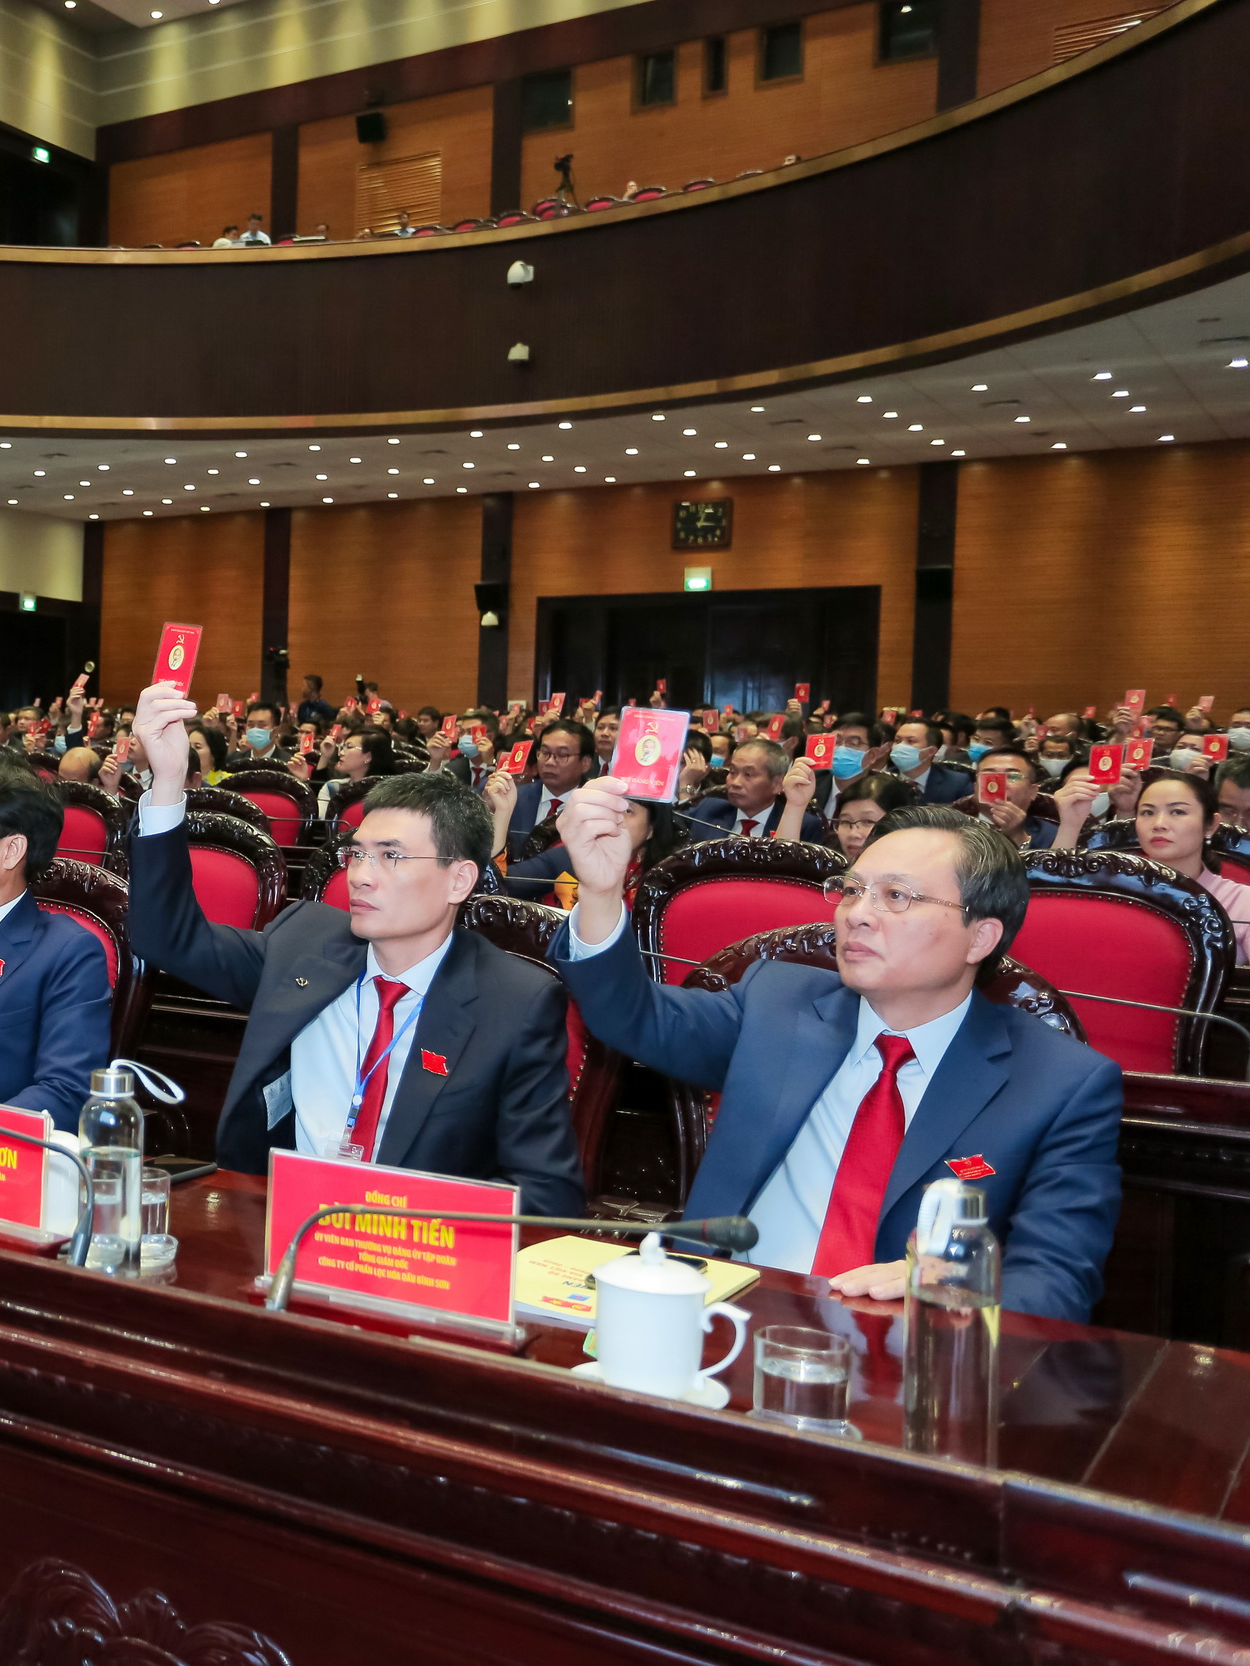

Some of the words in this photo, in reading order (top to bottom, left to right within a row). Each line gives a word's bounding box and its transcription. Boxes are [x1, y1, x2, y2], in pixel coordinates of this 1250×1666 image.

[391, 1195, 407, 1208] CHÍ
[354, 1212, 407, 1240] MINH
[410, 1218, 455, 1249] TIẾN
